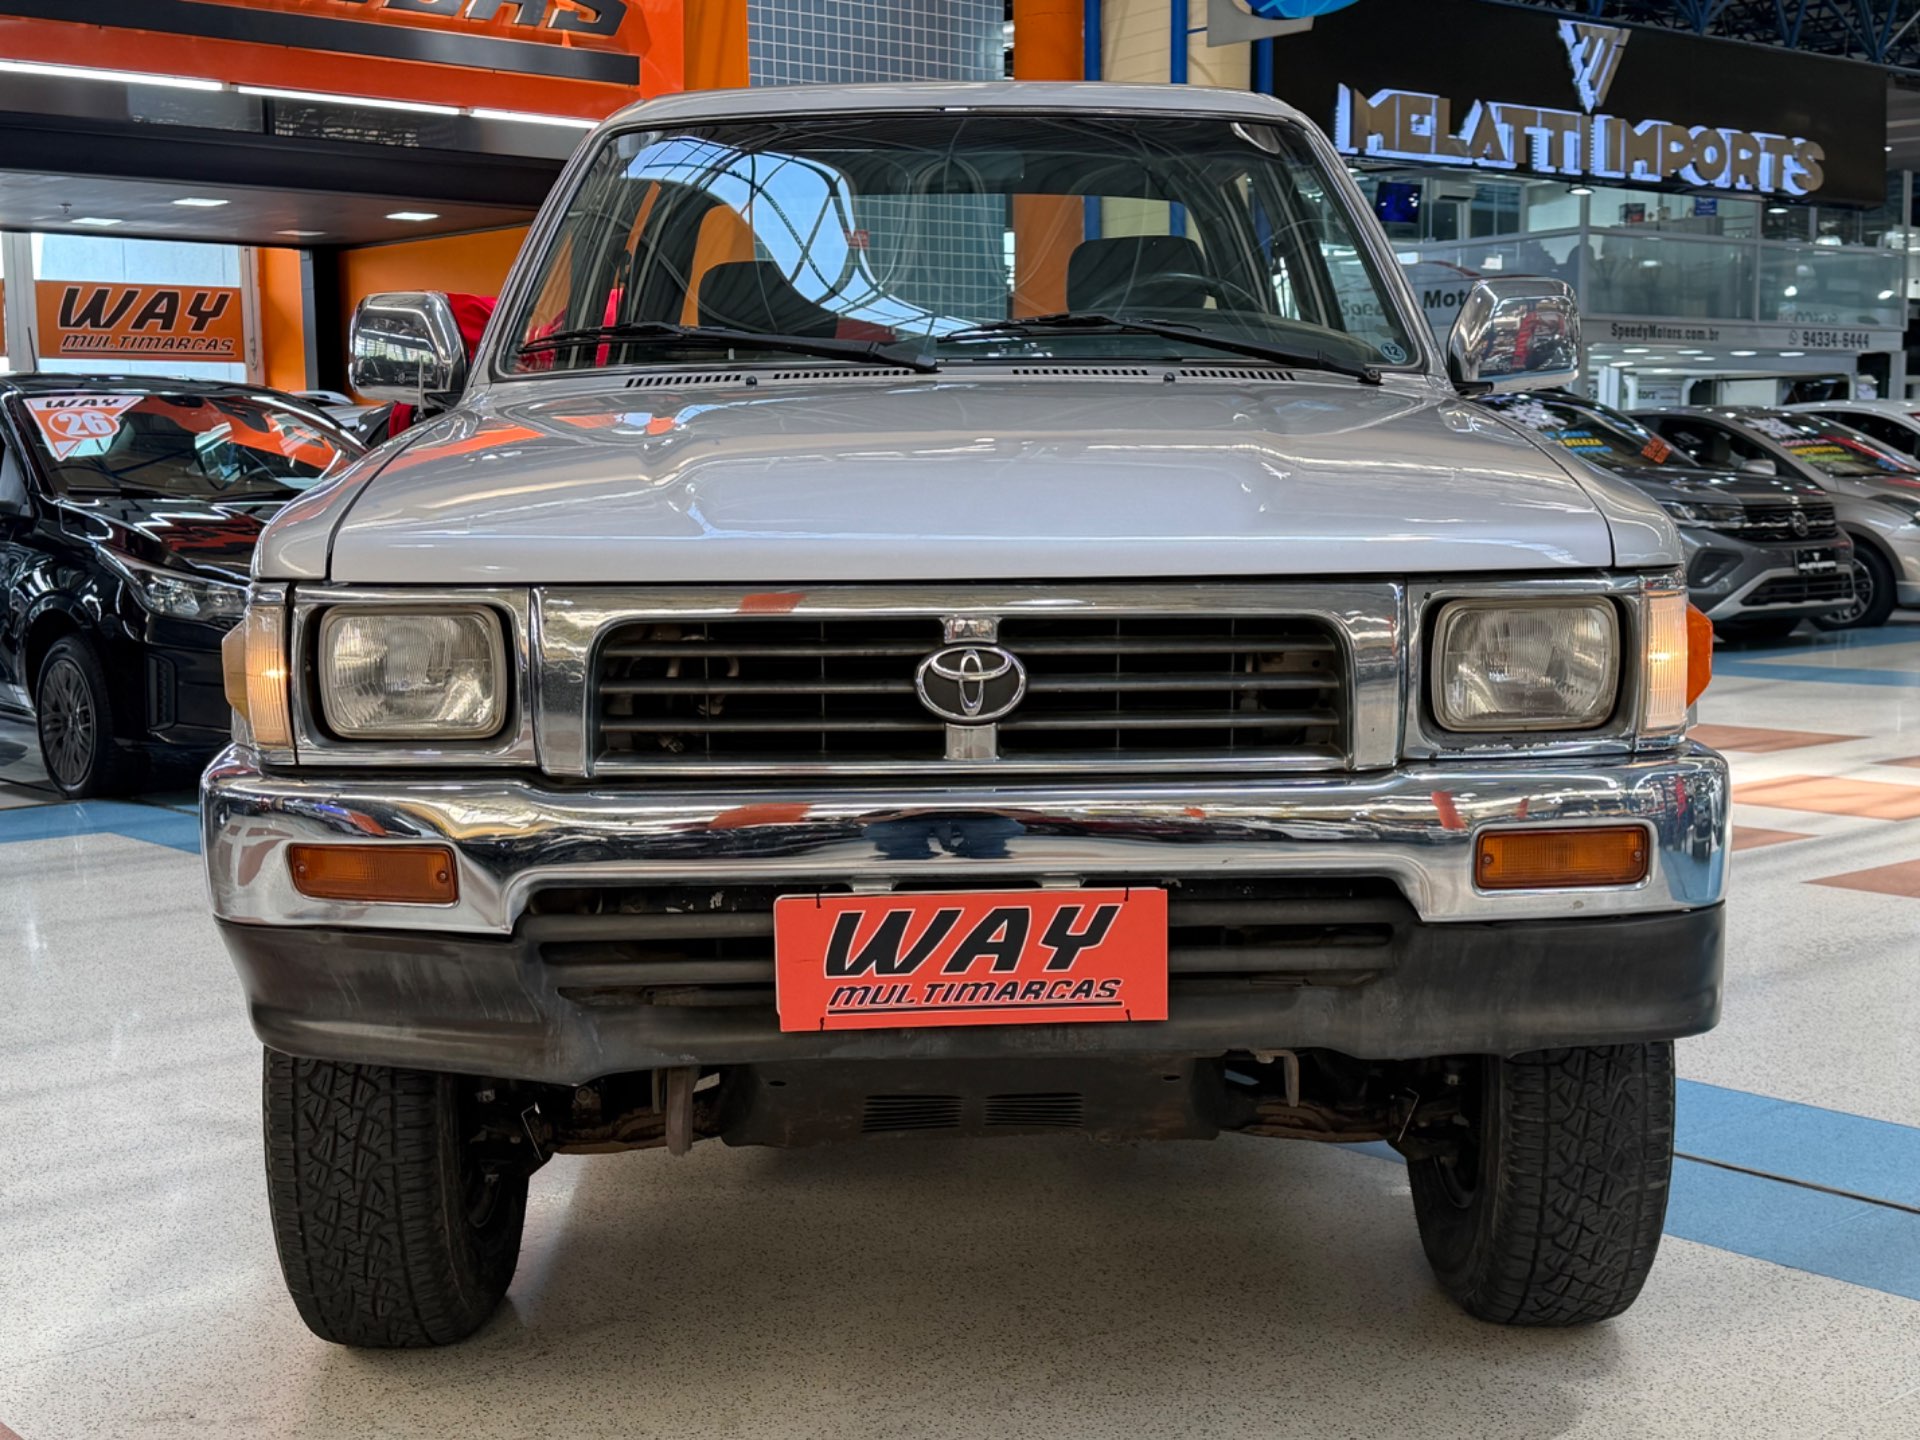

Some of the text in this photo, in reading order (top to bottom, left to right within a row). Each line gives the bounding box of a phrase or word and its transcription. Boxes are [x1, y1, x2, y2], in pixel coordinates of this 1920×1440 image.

[1334, 81, 1827, 196] MELATTI IMPORTS
[58, 286, 233, 334] WAY
[1423, 289, 1467, 309] Mot
[60, 334, 234, 351] MULTIMARCAS
[1610, 322, 1870, 349] SpeedyMotors.com.br 94334-6444
[45, 398, 119, 409] WAY
[58, 411, 114, 436] 26
[824, 904, 1123, 979] WAY
[827, 979, 1124, 1008] MULTIMARCAS
